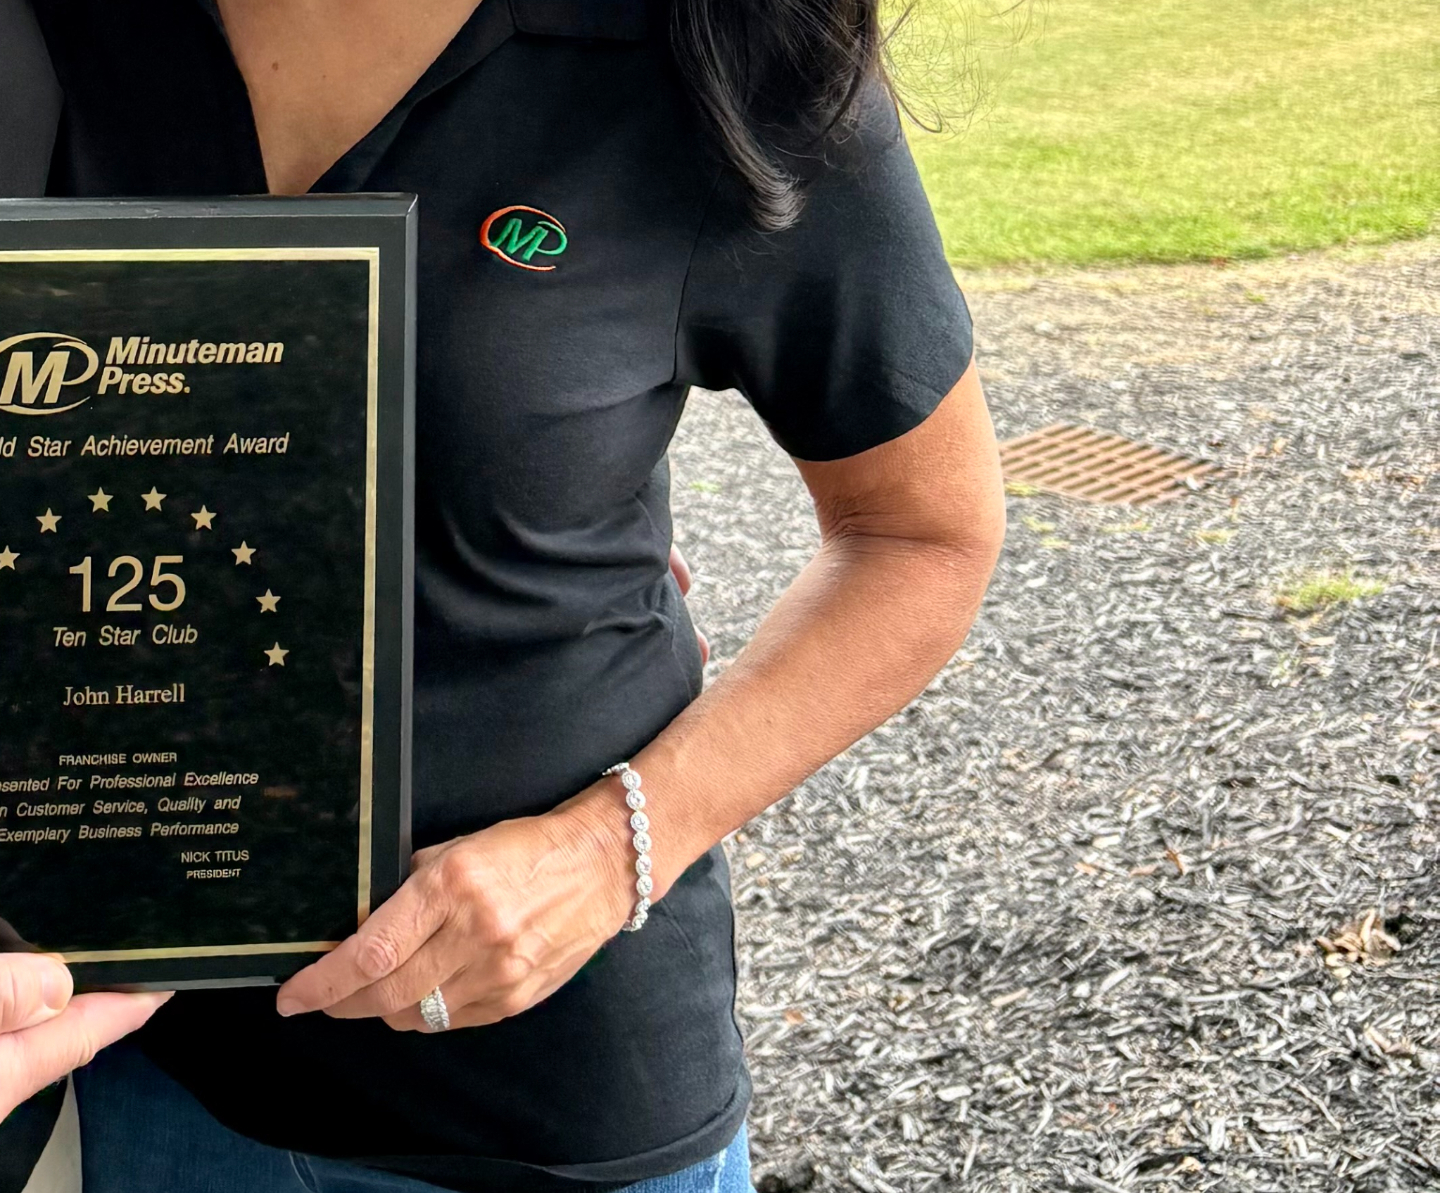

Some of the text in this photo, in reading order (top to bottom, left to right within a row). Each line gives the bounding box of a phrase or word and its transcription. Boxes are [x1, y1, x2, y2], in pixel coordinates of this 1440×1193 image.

[105, 336, 285, 365] Minuteman
[27, 435, 72, 458] Star
[80, 434, 215, 457] Achievement
[222, 431, 290, 455] Award
[68, 554, 187, 613] 125
[52, 623, 199, 647] Ten Star Club
[63, 682, 186, 706] John Harrell
[58, 752, 178, 767] FRANCHISE OWNER
[57, 775, 83, 791] For
[89, 772, 177, 790] Professional
[183, 770, 260, 787] Excellence
[16, 802, 86, 818] Customer
[92, 799, 149, 815] Service,
[157, 796, 207, 814] Quality
[213, 795, 242, 810] and
[78, 824, 143, 840] Business
[150, 820, 240, 837] Performance
[180, 849, 251, 864] NICK TITUS
[186, 868, 242, 880] PRESIDENT
